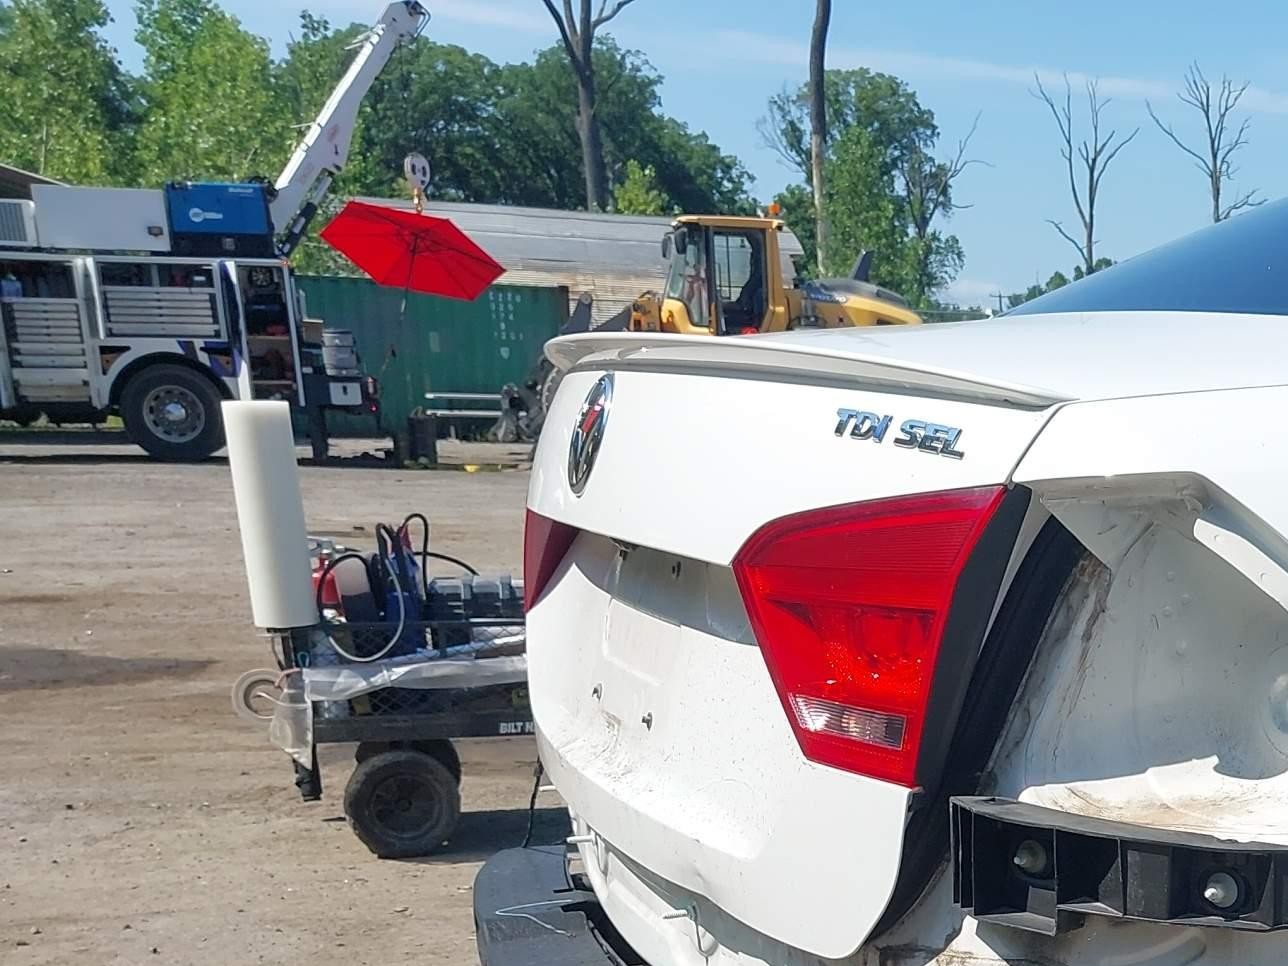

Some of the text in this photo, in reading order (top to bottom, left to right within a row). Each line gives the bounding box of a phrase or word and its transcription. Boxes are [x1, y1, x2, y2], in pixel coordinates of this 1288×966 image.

[834, 407, 965, 460] TDI SEL
[499, 722, 523, 734] BILT
